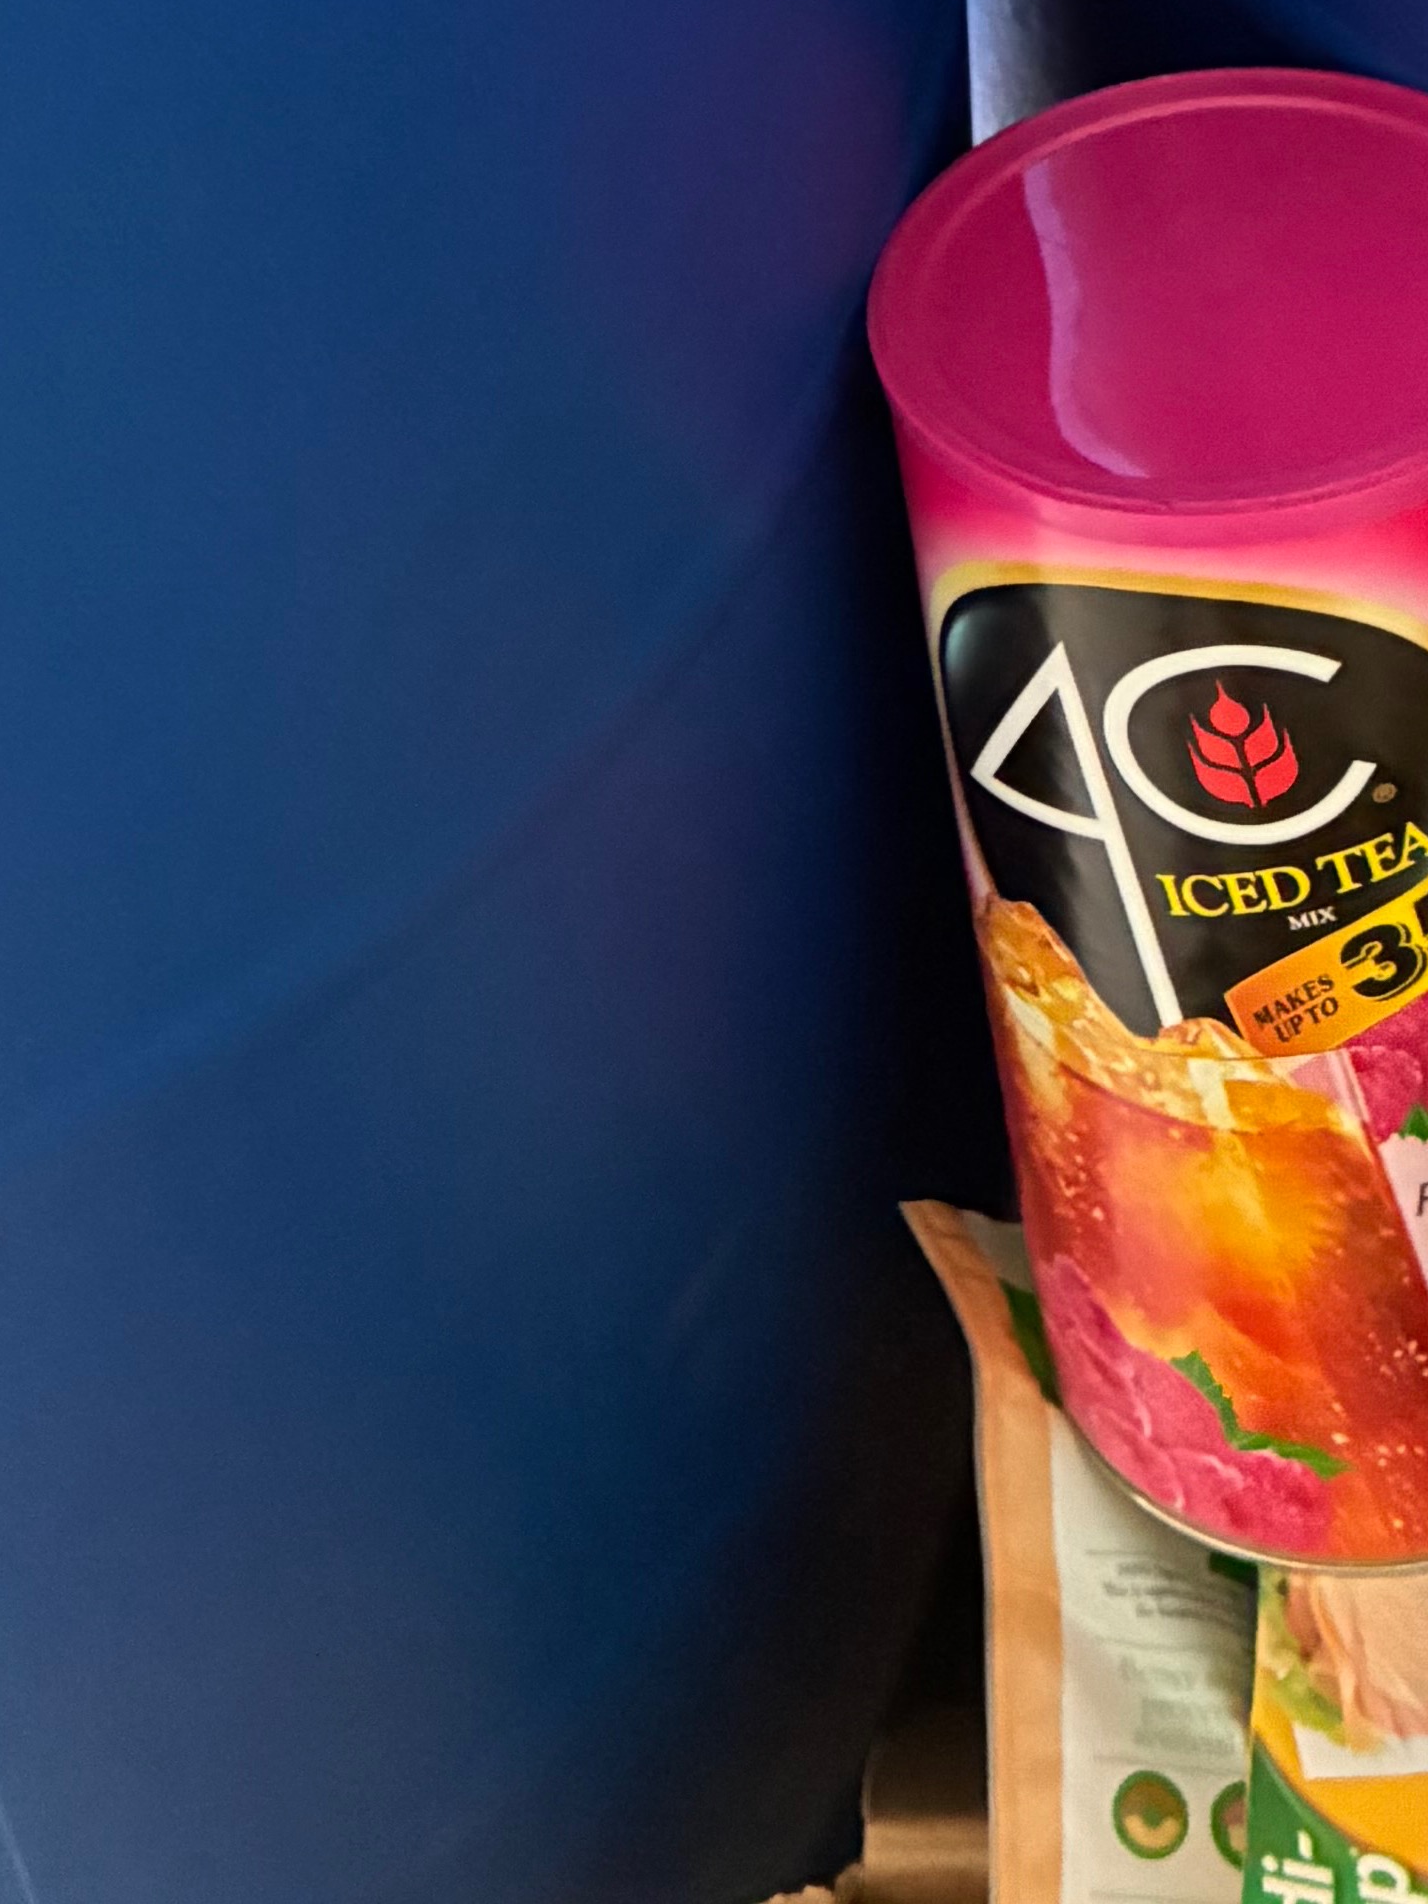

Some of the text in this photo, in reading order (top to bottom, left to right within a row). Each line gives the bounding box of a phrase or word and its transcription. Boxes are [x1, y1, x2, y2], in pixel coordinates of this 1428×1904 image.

[970, 640, 1377, 1027] 4C
[1155, 866, 1311, 918] ICED
[1286, 906, 1338, 931] MIX
[1252, 973, 1336, 1028] MAKES
[1274, 996, 1339, 1042] UP TO
